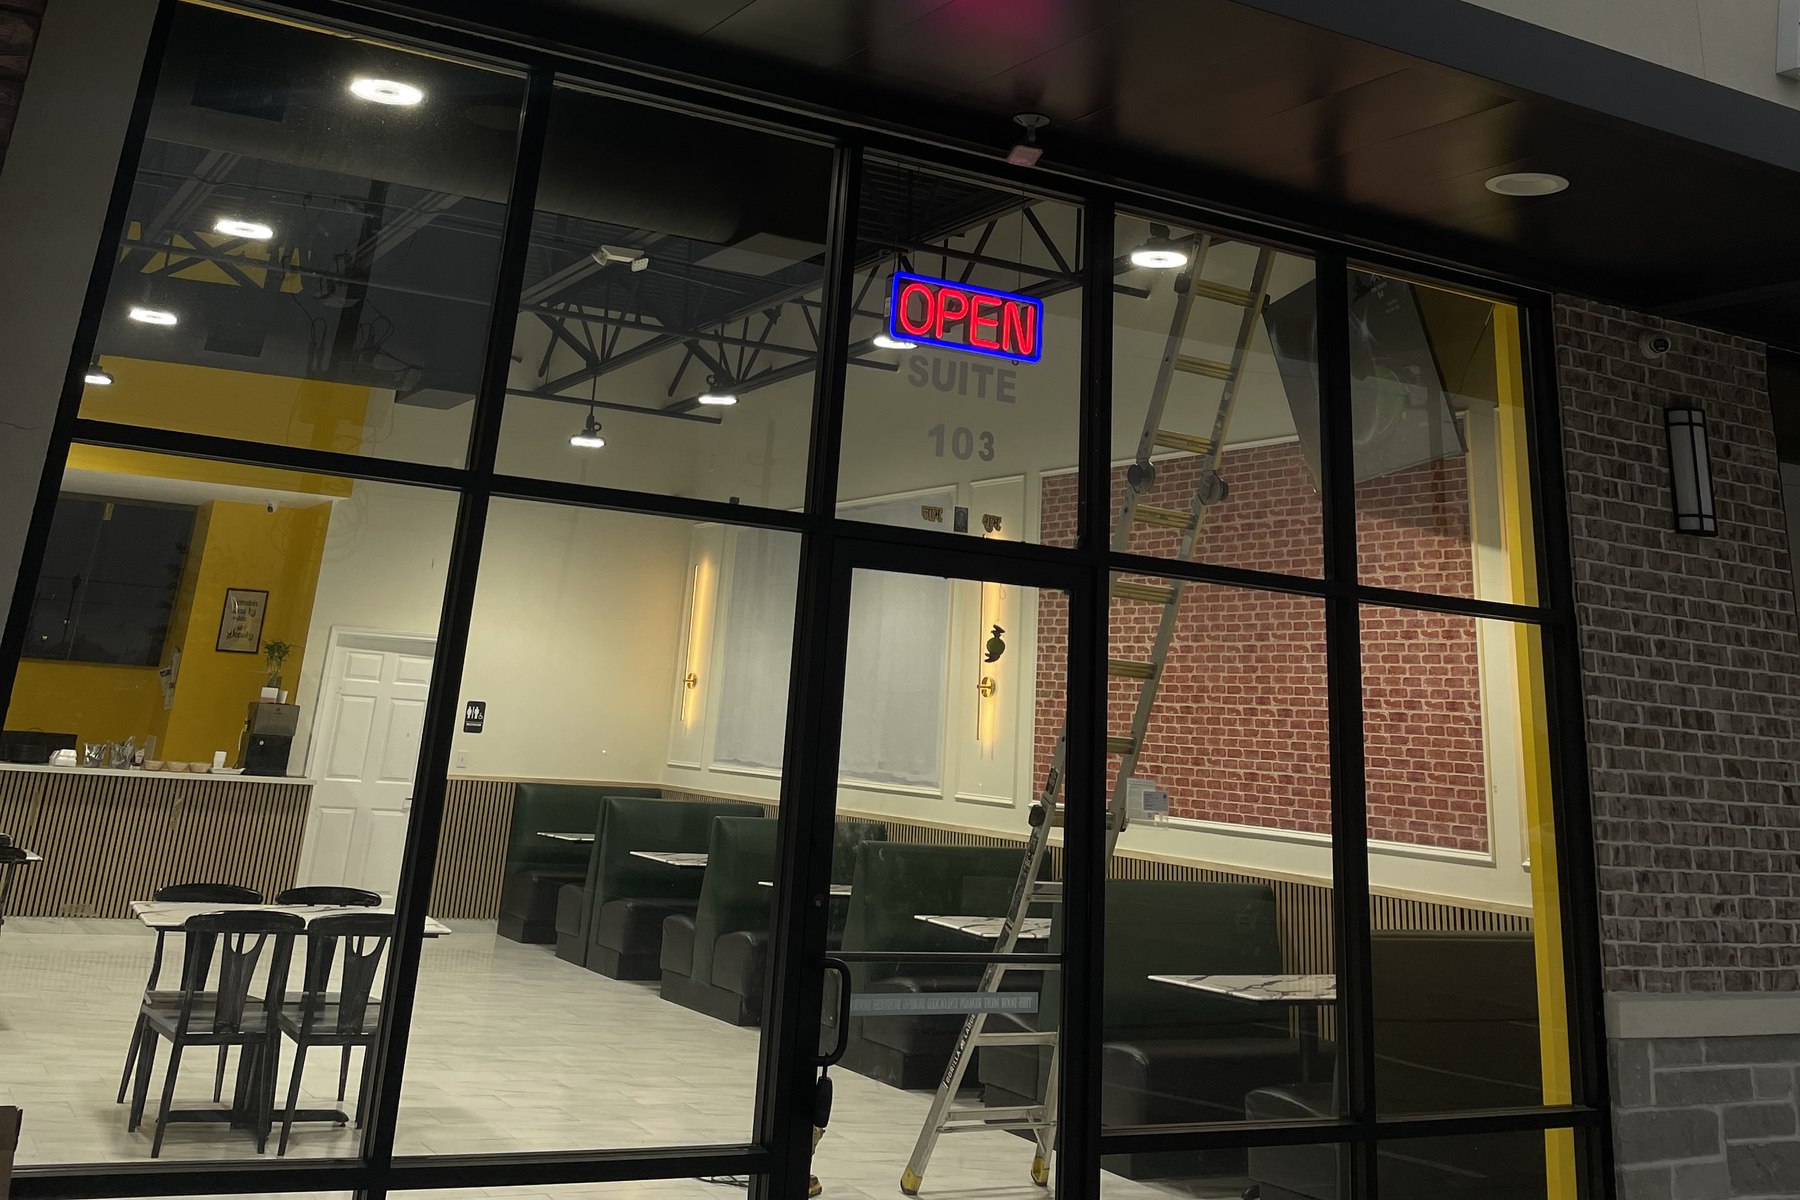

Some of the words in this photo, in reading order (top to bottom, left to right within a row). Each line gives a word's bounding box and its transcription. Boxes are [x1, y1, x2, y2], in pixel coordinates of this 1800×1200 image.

[899, 283, 1035, 356] OPEN
[907, 354, 1017, 404] SUITE
[927, 422, 996, 462] 103
